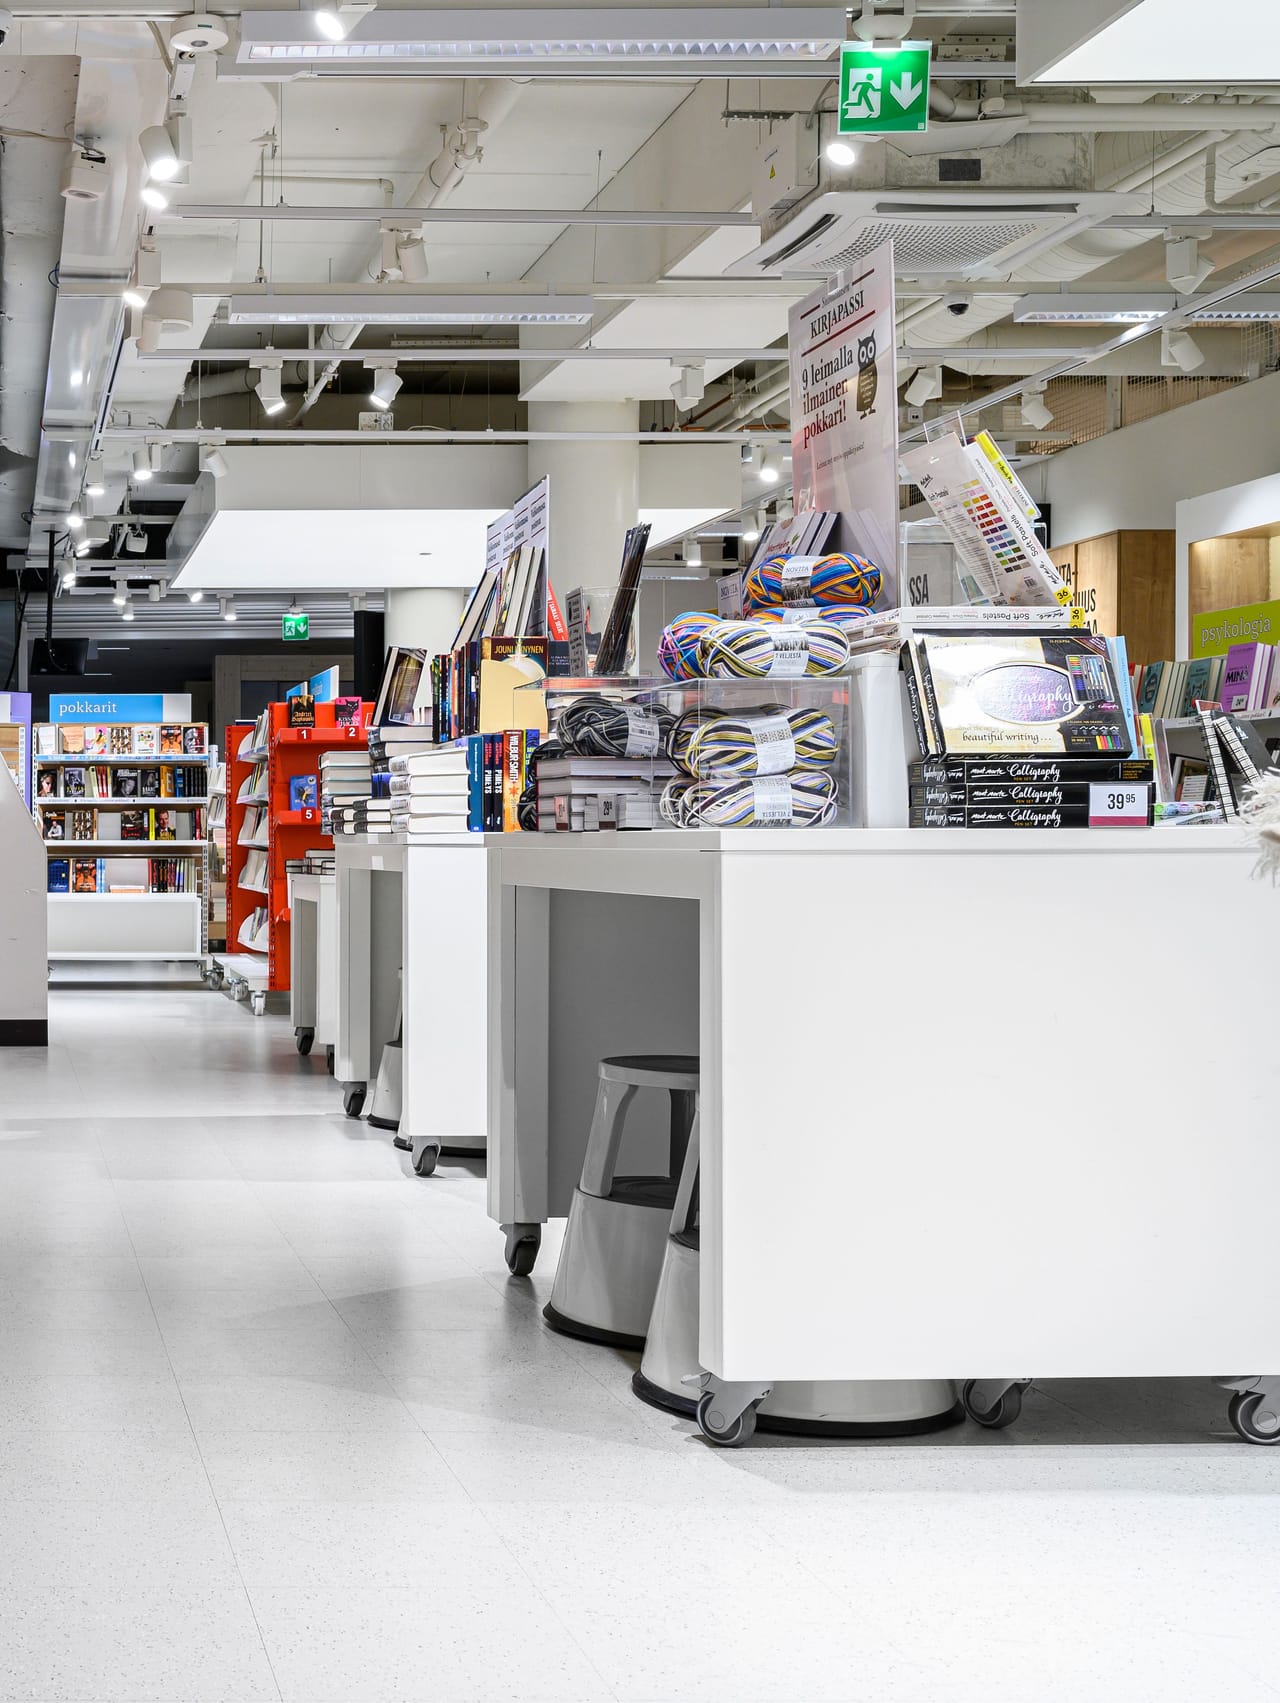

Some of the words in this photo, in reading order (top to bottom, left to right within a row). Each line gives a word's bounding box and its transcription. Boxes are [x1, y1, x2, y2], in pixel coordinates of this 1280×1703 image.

[810, 290, 865, 339] KIRJAPASSI
[810, 346, 853, 386] leimalla
[803, 378, 849, 415] ilmainen
[803, 400, 847, 449] pokkari!
[786, 565, 809, 573] NOVITA
[1057, 589, 1069, 599] 36
[982, 612, 1011, 621] Pastels
[1072, 609, 1080, 620] 36
[1201, 614, 1271, 648] psykologia
[494, 644, 514, 654] JOUNI
[59, 701, 118, 717] pokkarit
[301, 730, 307, 739] 1
[348, 728, 356, 737] 2
[963, 731, 1003, 746] beautiful
[509, 735, 519, 758] WILBUR
[509, 760, 519, 782] SMITH
[1006, 763, 1061, 782] Calligraphy
[1009, 785, 1064, 804] Calligraphy
[1107, 793, 1124, 810] 39
[1125, 793, 1136, 803] 95
[305, 809, 313, 818] 5
[1007, 808, 1062, 827] Calligraphy
